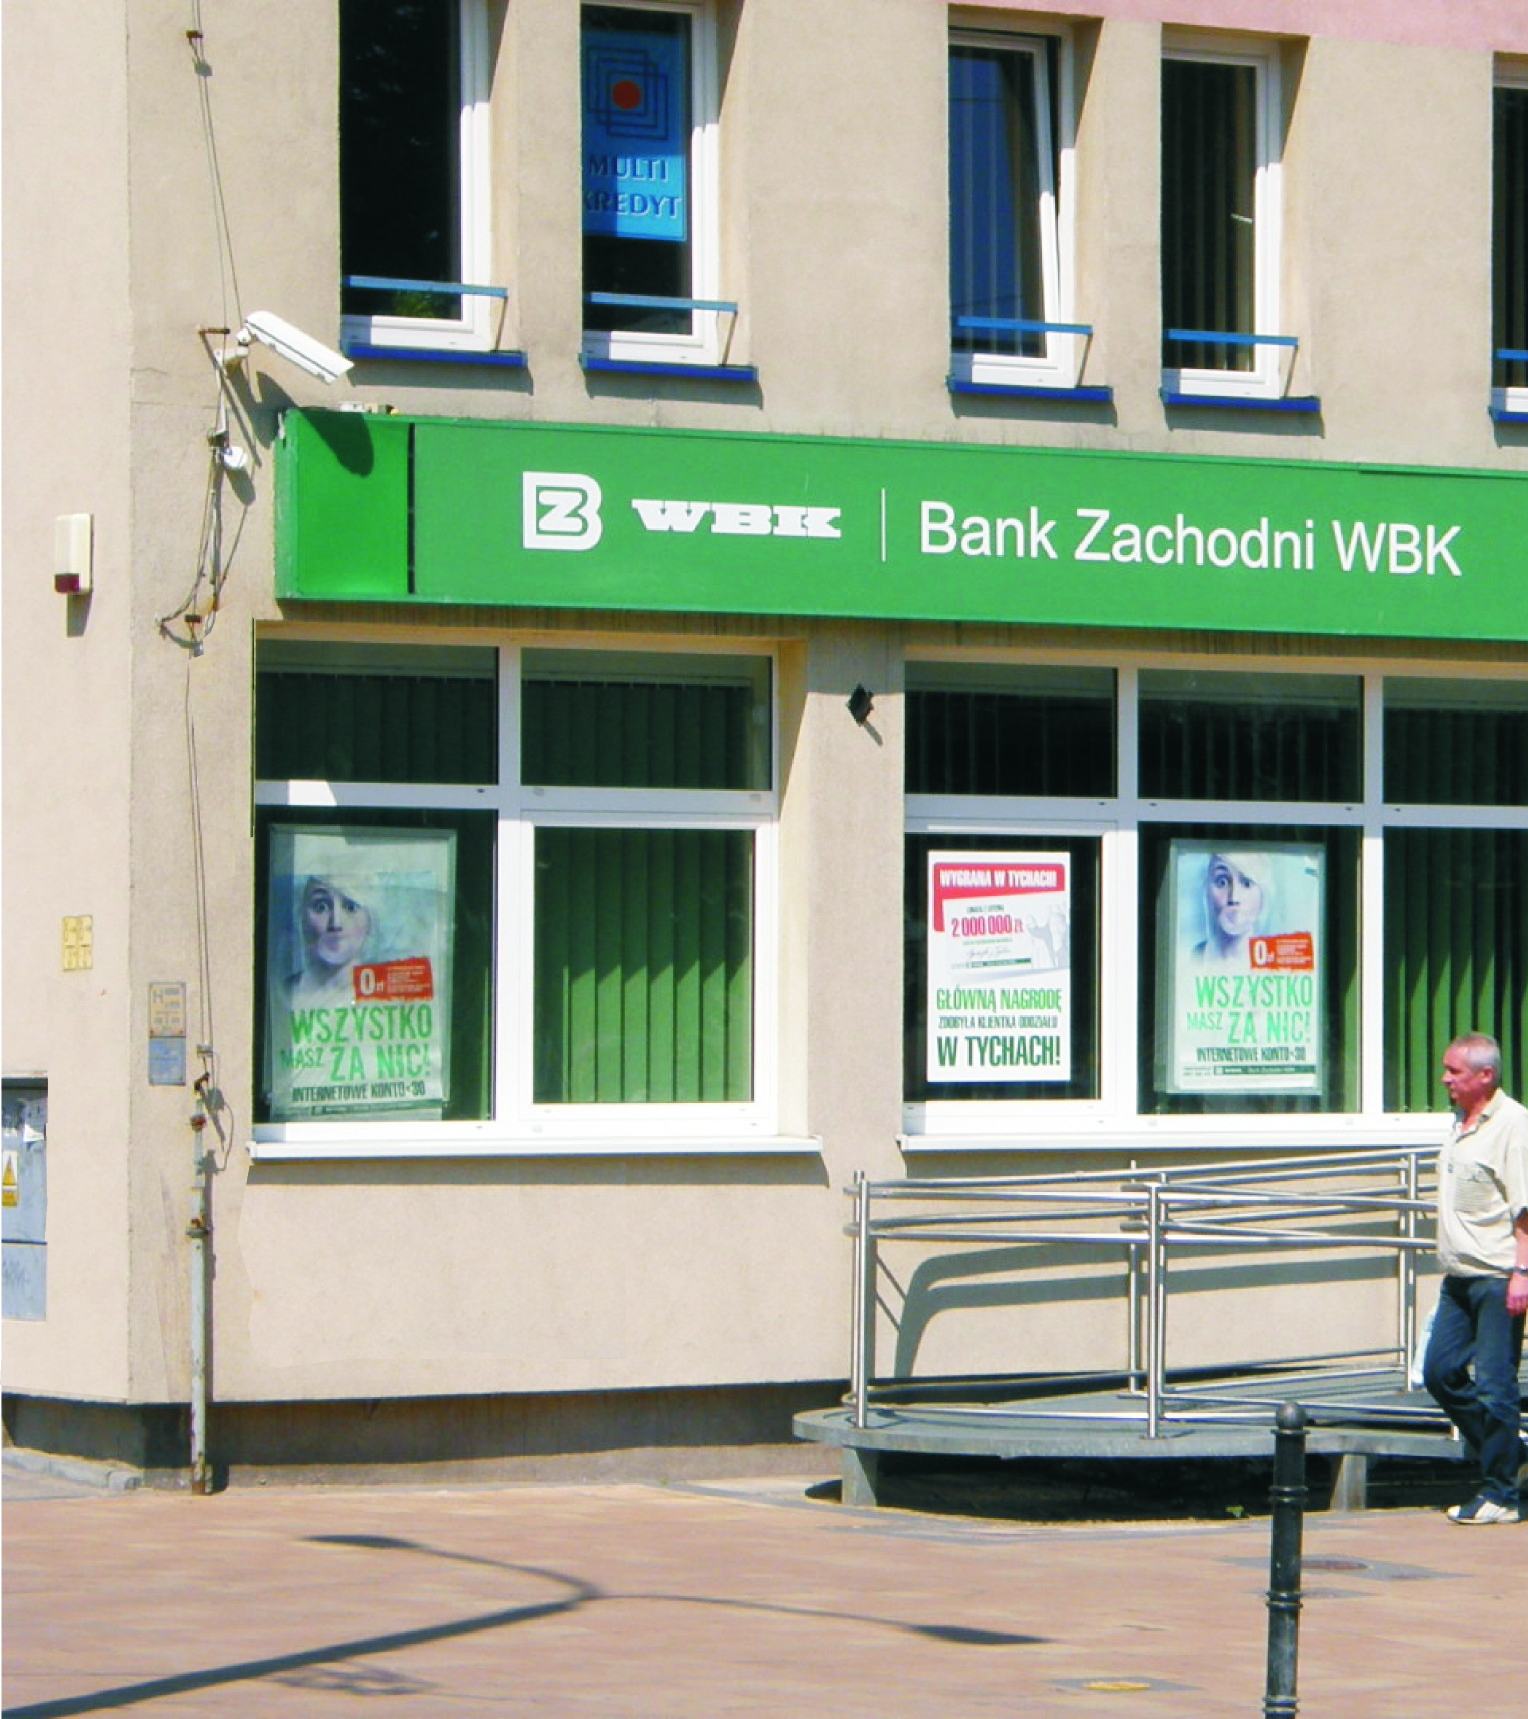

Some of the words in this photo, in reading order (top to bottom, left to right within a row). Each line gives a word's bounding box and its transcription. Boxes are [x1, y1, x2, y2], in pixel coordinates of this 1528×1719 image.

[588, 155, 669, 182] MULTI
[631, 499, 841, 538] WBK
[920, 500, 1058, 559] Bank
[1074, 508, 1314, 570] Zachodni
[1332, 520, 1462, 576] WBK
[952, 919, 960, 937] 2
[962, 916, 985, 937] 000
[988, 915, 1013, 935] 000
[1254, 941, 1268, 966] 0
[360, 969, 376, 996] 0
[936, 985, 996, 1012] GŁÓWNĄ
[1001, 988, 1061, 1012] NAGRODĘ
[1195, 975, 1313, 1008] WSZYSTKO
[290, 1004, 433, 1044] WSZYSTKO
[1187, 1012, 1223, 1031] MASZ
[1227, 1012, 1258, 1044] ZA
[1266, 1012, 1311, 1044] NIC!
[330, 1047, 365, 1083] ZA
[377, 1043, 432, 1079] NIC!
[936, 1035, 958, 1067] W
[964, 1035, 1061, 1067] TYCHACH!
